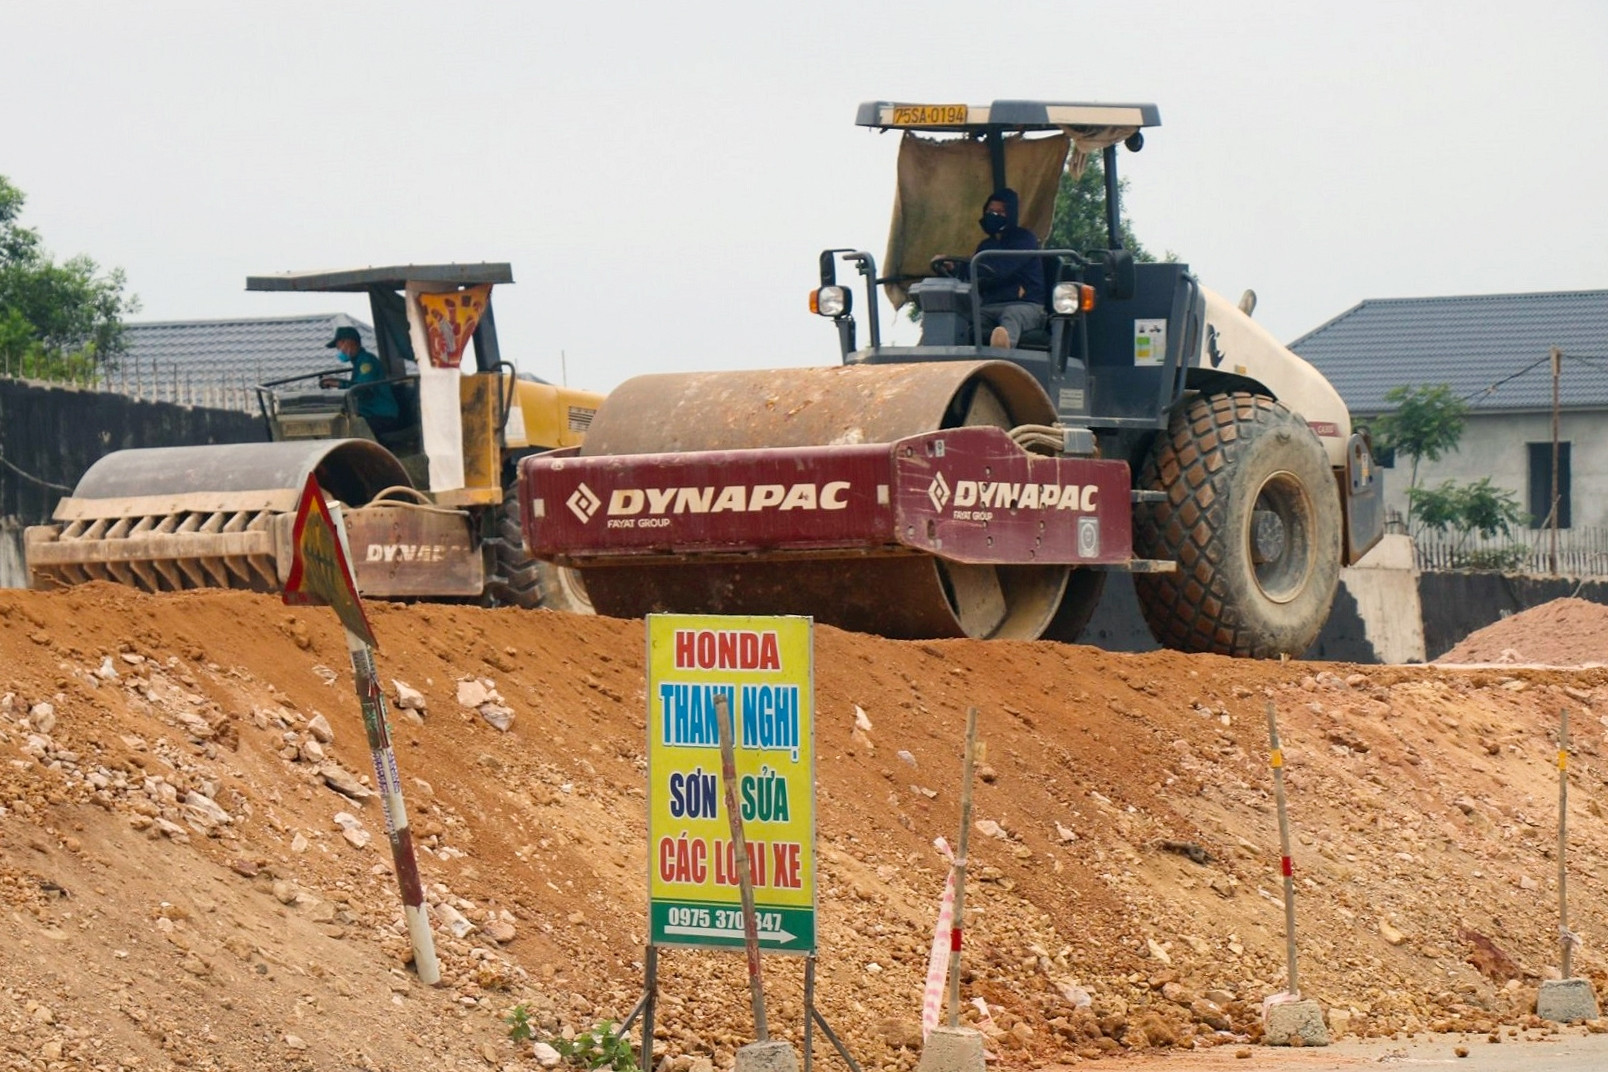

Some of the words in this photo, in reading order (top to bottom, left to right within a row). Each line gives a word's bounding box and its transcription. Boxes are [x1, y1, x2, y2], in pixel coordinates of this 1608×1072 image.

[607, 481, 850, 515] DYNAPAC
[953, 480, 1099, 512] DYNAPAC
[607, 519, 634, 528] FAYAT
[637, 518, 670, 528] GROUP
[676, 631, 780, 670] HONDA
[742, 685, 798, 760] NGHỊ
[670, 768, 717, 819] SƠN
[741, 766, 789, 822] SỬA
[660, 832, 707, 884] CÁC
[773, 843, 802, 888] XE
[668, 907, 710, 926] 0975
[715, 910, 744, 930] 370
